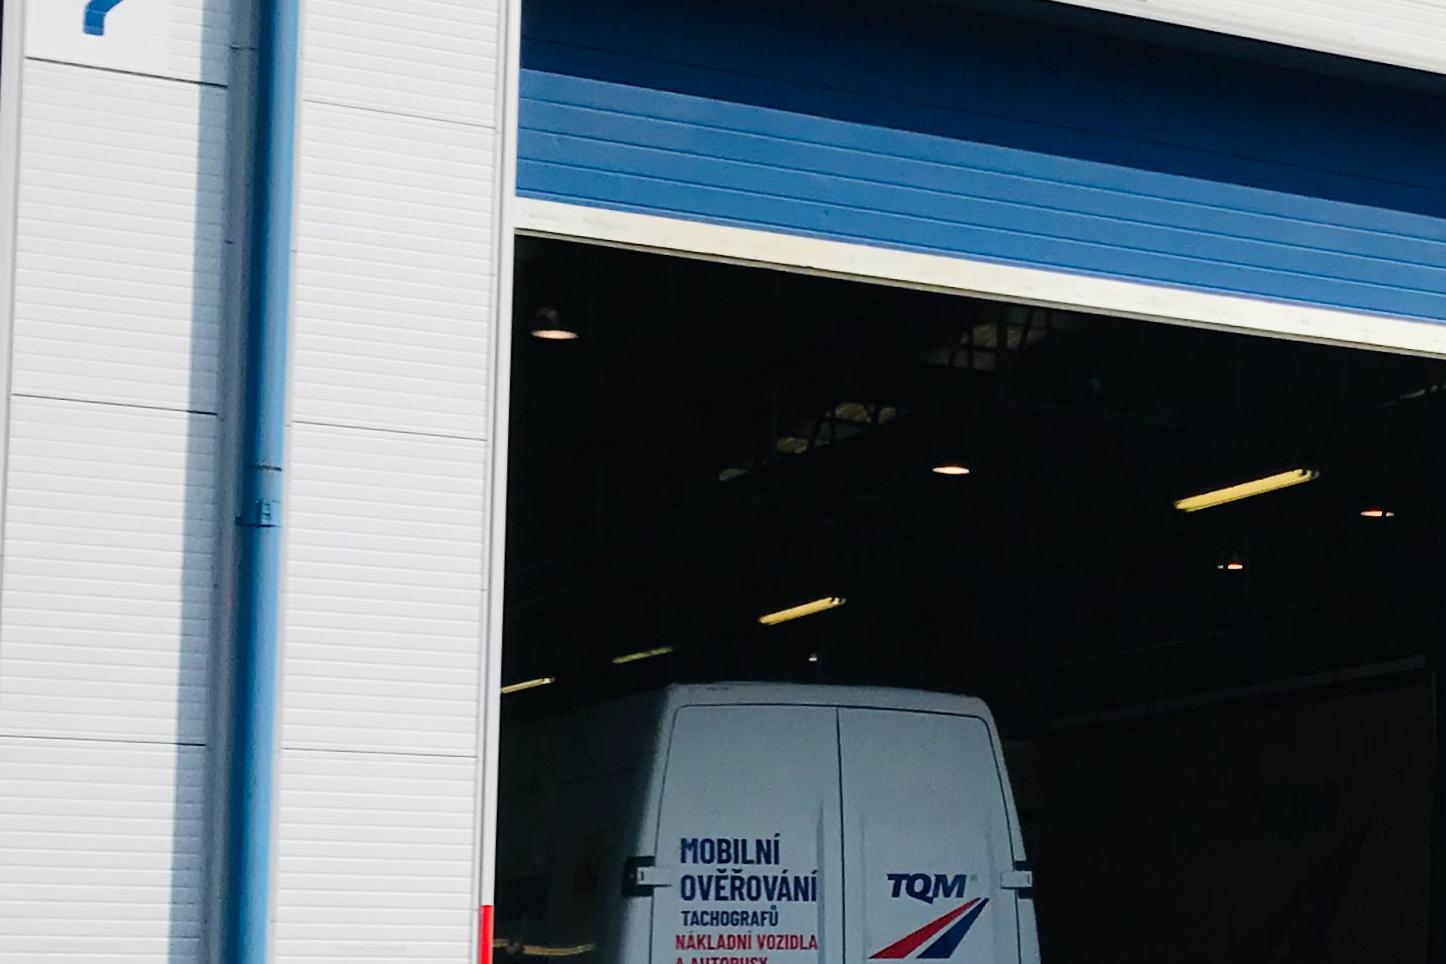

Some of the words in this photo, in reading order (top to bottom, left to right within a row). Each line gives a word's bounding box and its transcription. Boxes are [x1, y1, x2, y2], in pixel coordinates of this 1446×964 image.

[680, 832, 780, 865] MOBILNÍ
[680, 868, 818, 902] OVĚŘOVÁNÍ
[886, 873, 967, 905] TQM
[680, 904, 779, 928] TACHOGRAFŮ
[675, 930, 753, 951] NÁKLADNÍ
[756, 933, 818, 951] VOZIDLA
